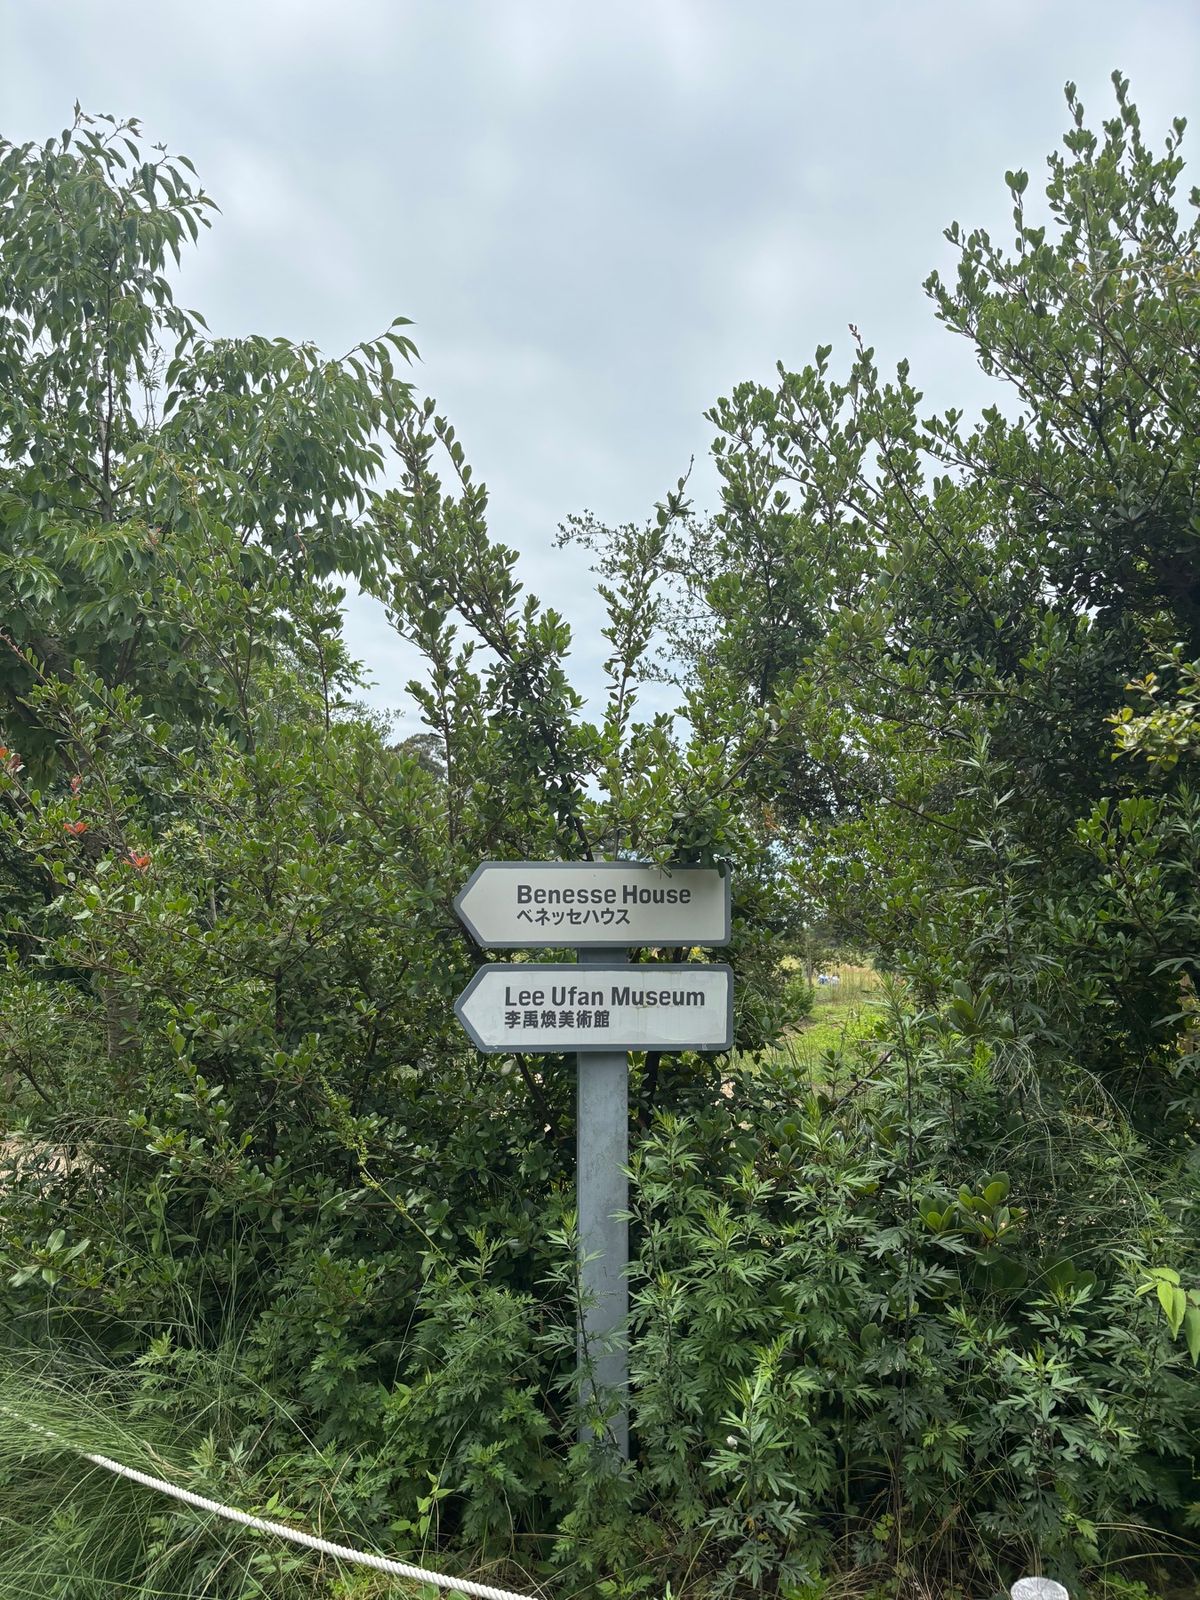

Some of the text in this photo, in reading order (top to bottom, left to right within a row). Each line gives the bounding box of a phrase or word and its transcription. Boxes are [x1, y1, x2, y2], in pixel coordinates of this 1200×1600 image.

[517, 884, 692, 905] Benesse House
[516, 907, 631, 926] ベネッセハウス
[505, 986, 705, 1007] Lee Ufan Museum
